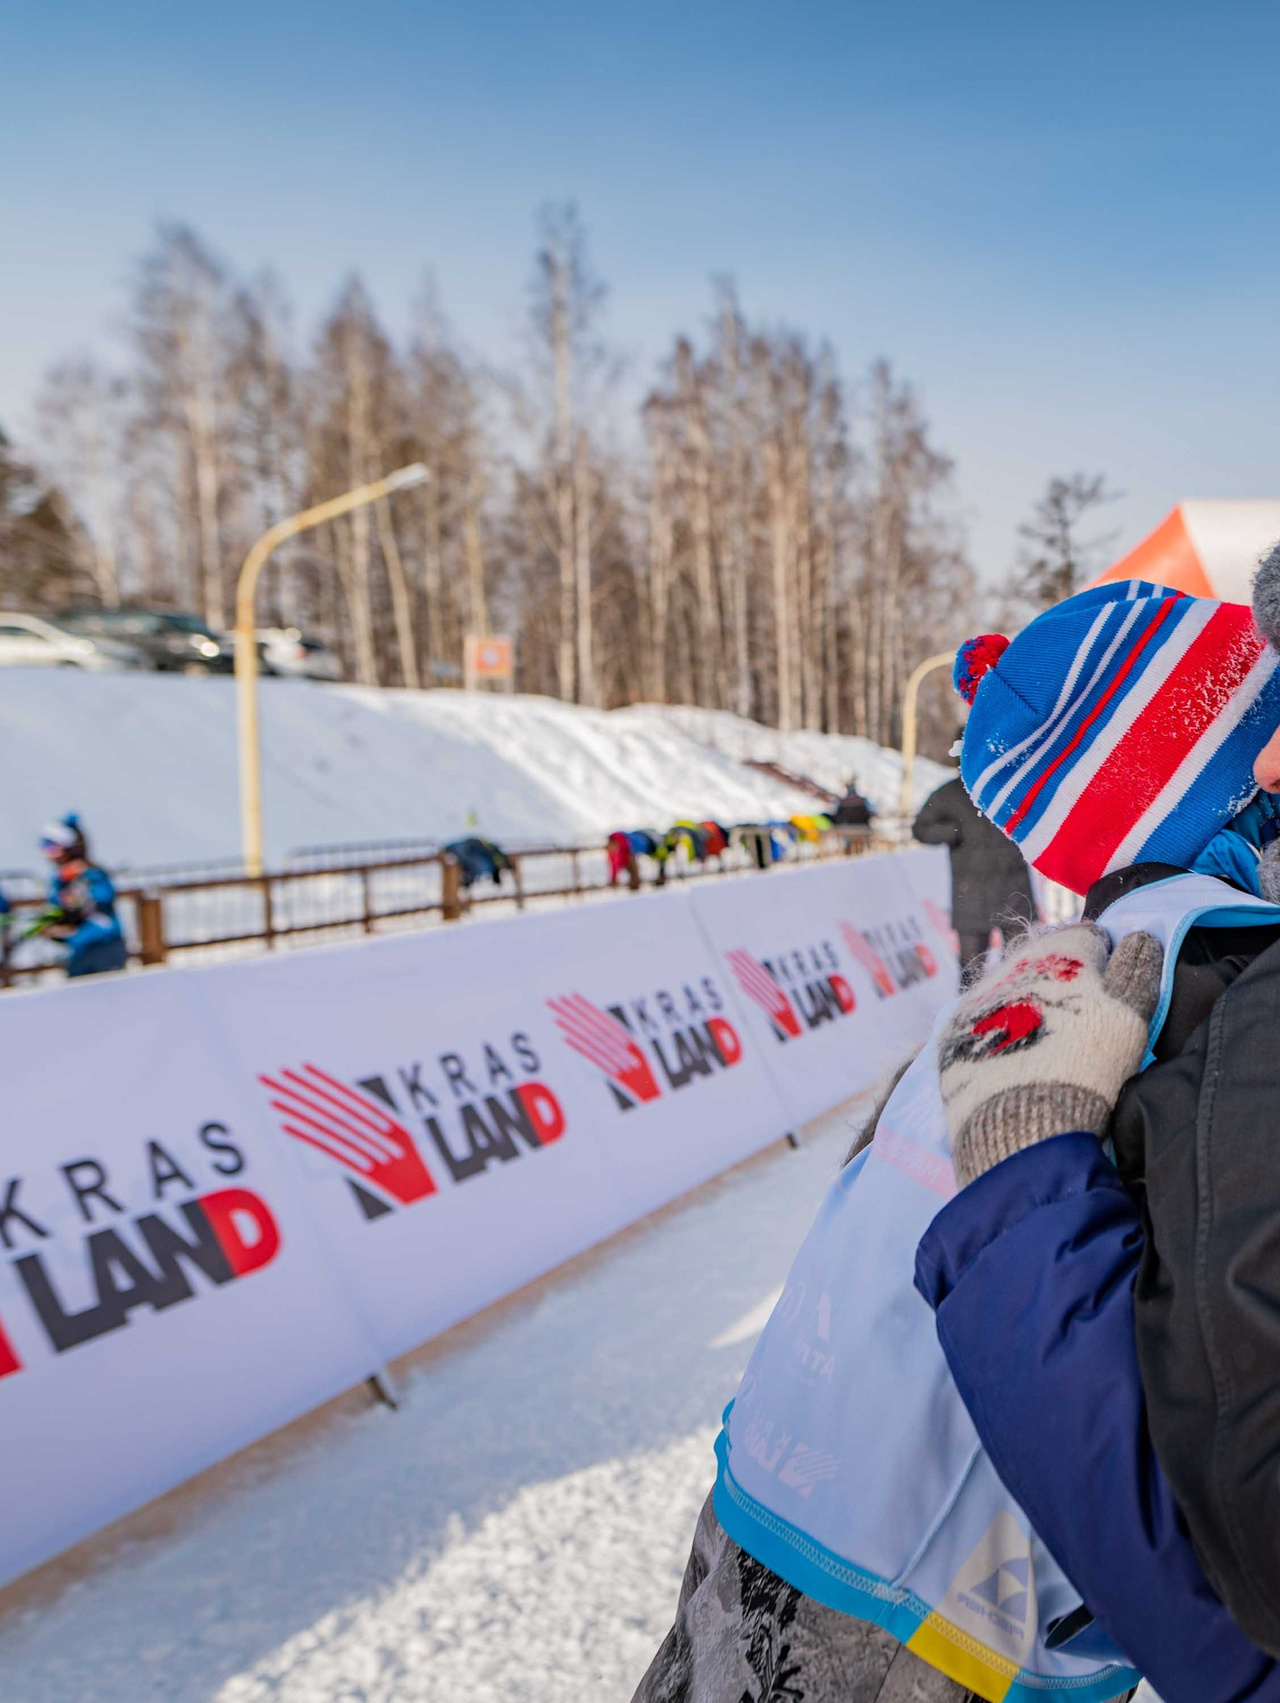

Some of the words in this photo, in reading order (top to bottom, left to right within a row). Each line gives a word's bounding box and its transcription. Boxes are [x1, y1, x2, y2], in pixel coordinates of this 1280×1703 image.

[630, 977, 722, 1036] KRAS
[792, 973, 856, 1030] LAND
[398, 1032, 541, 1112] KRAS
[651, 1015, 743, 1090] LAND
[424, 1081, 567, 1184] LAND
[0, 1121, 246, 1250] KRAS
[13, 1187, 281, 1354] LAND
